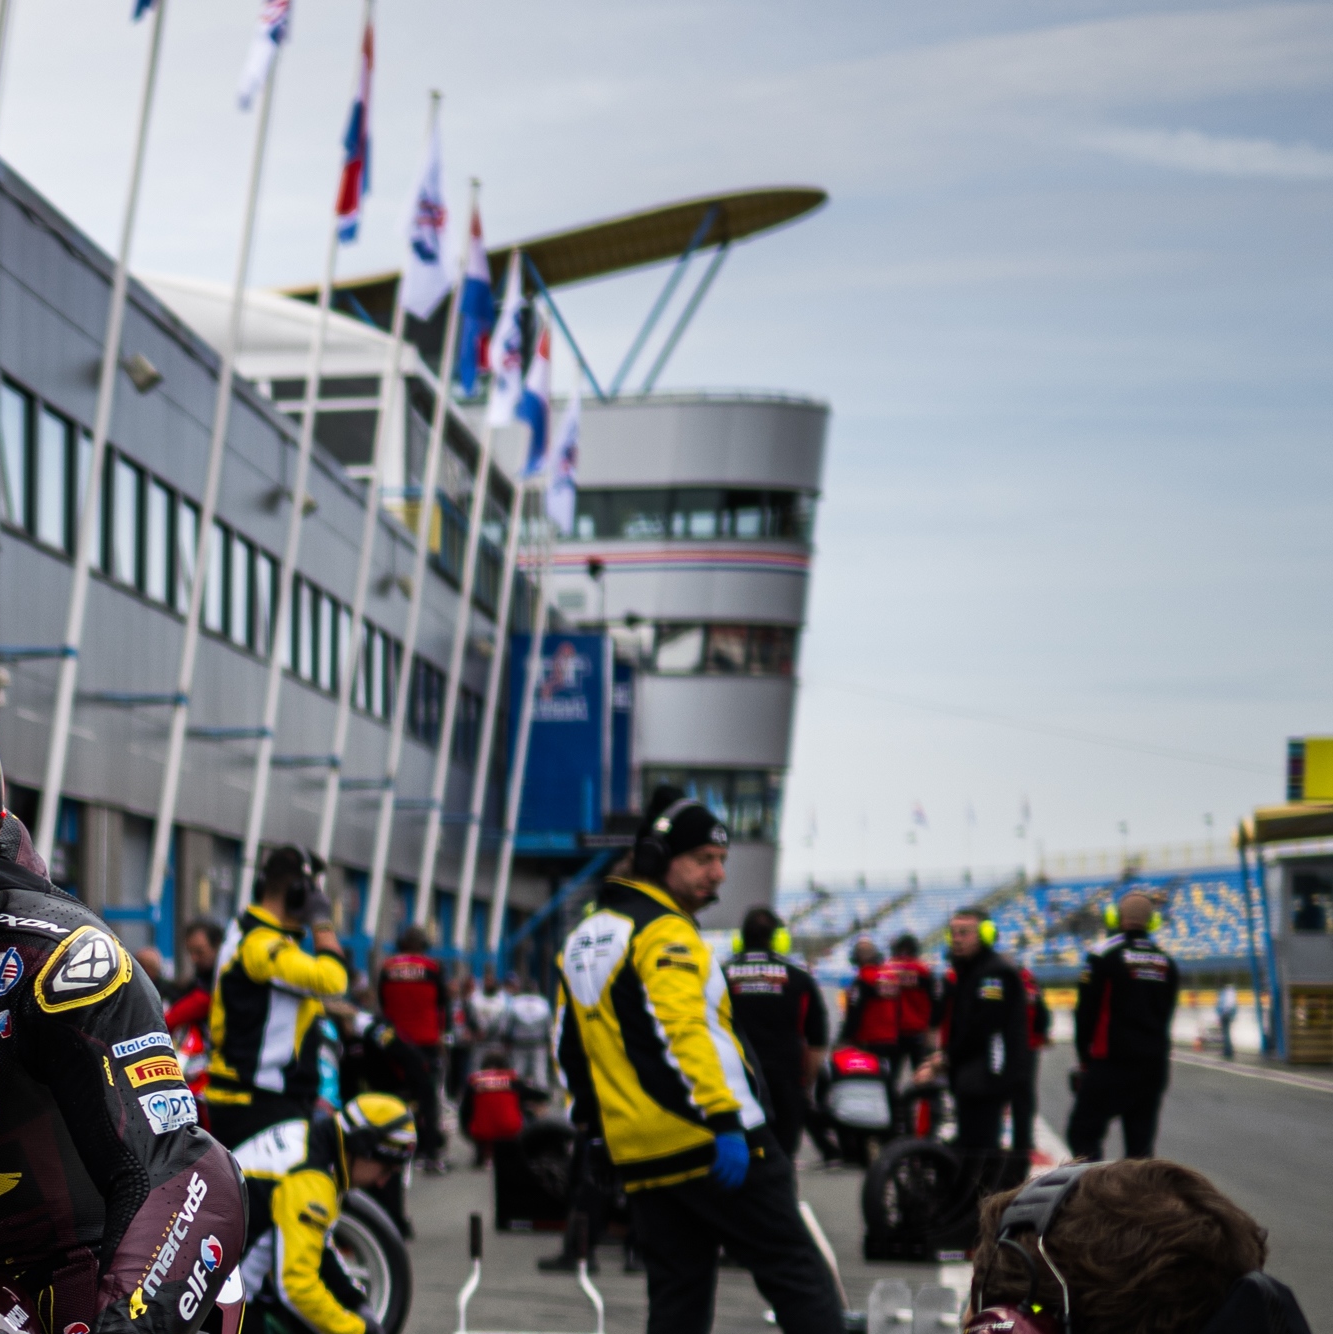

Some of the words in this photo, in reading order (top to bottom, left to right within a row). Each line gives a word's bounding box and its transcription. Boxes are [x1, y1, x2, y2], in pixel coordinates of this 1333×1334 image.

[135, 1060, 182, 1081] PIRELLI
[162, 1212, 178, 1239] TEAM
[179, 1259, 208, 1321] elf
